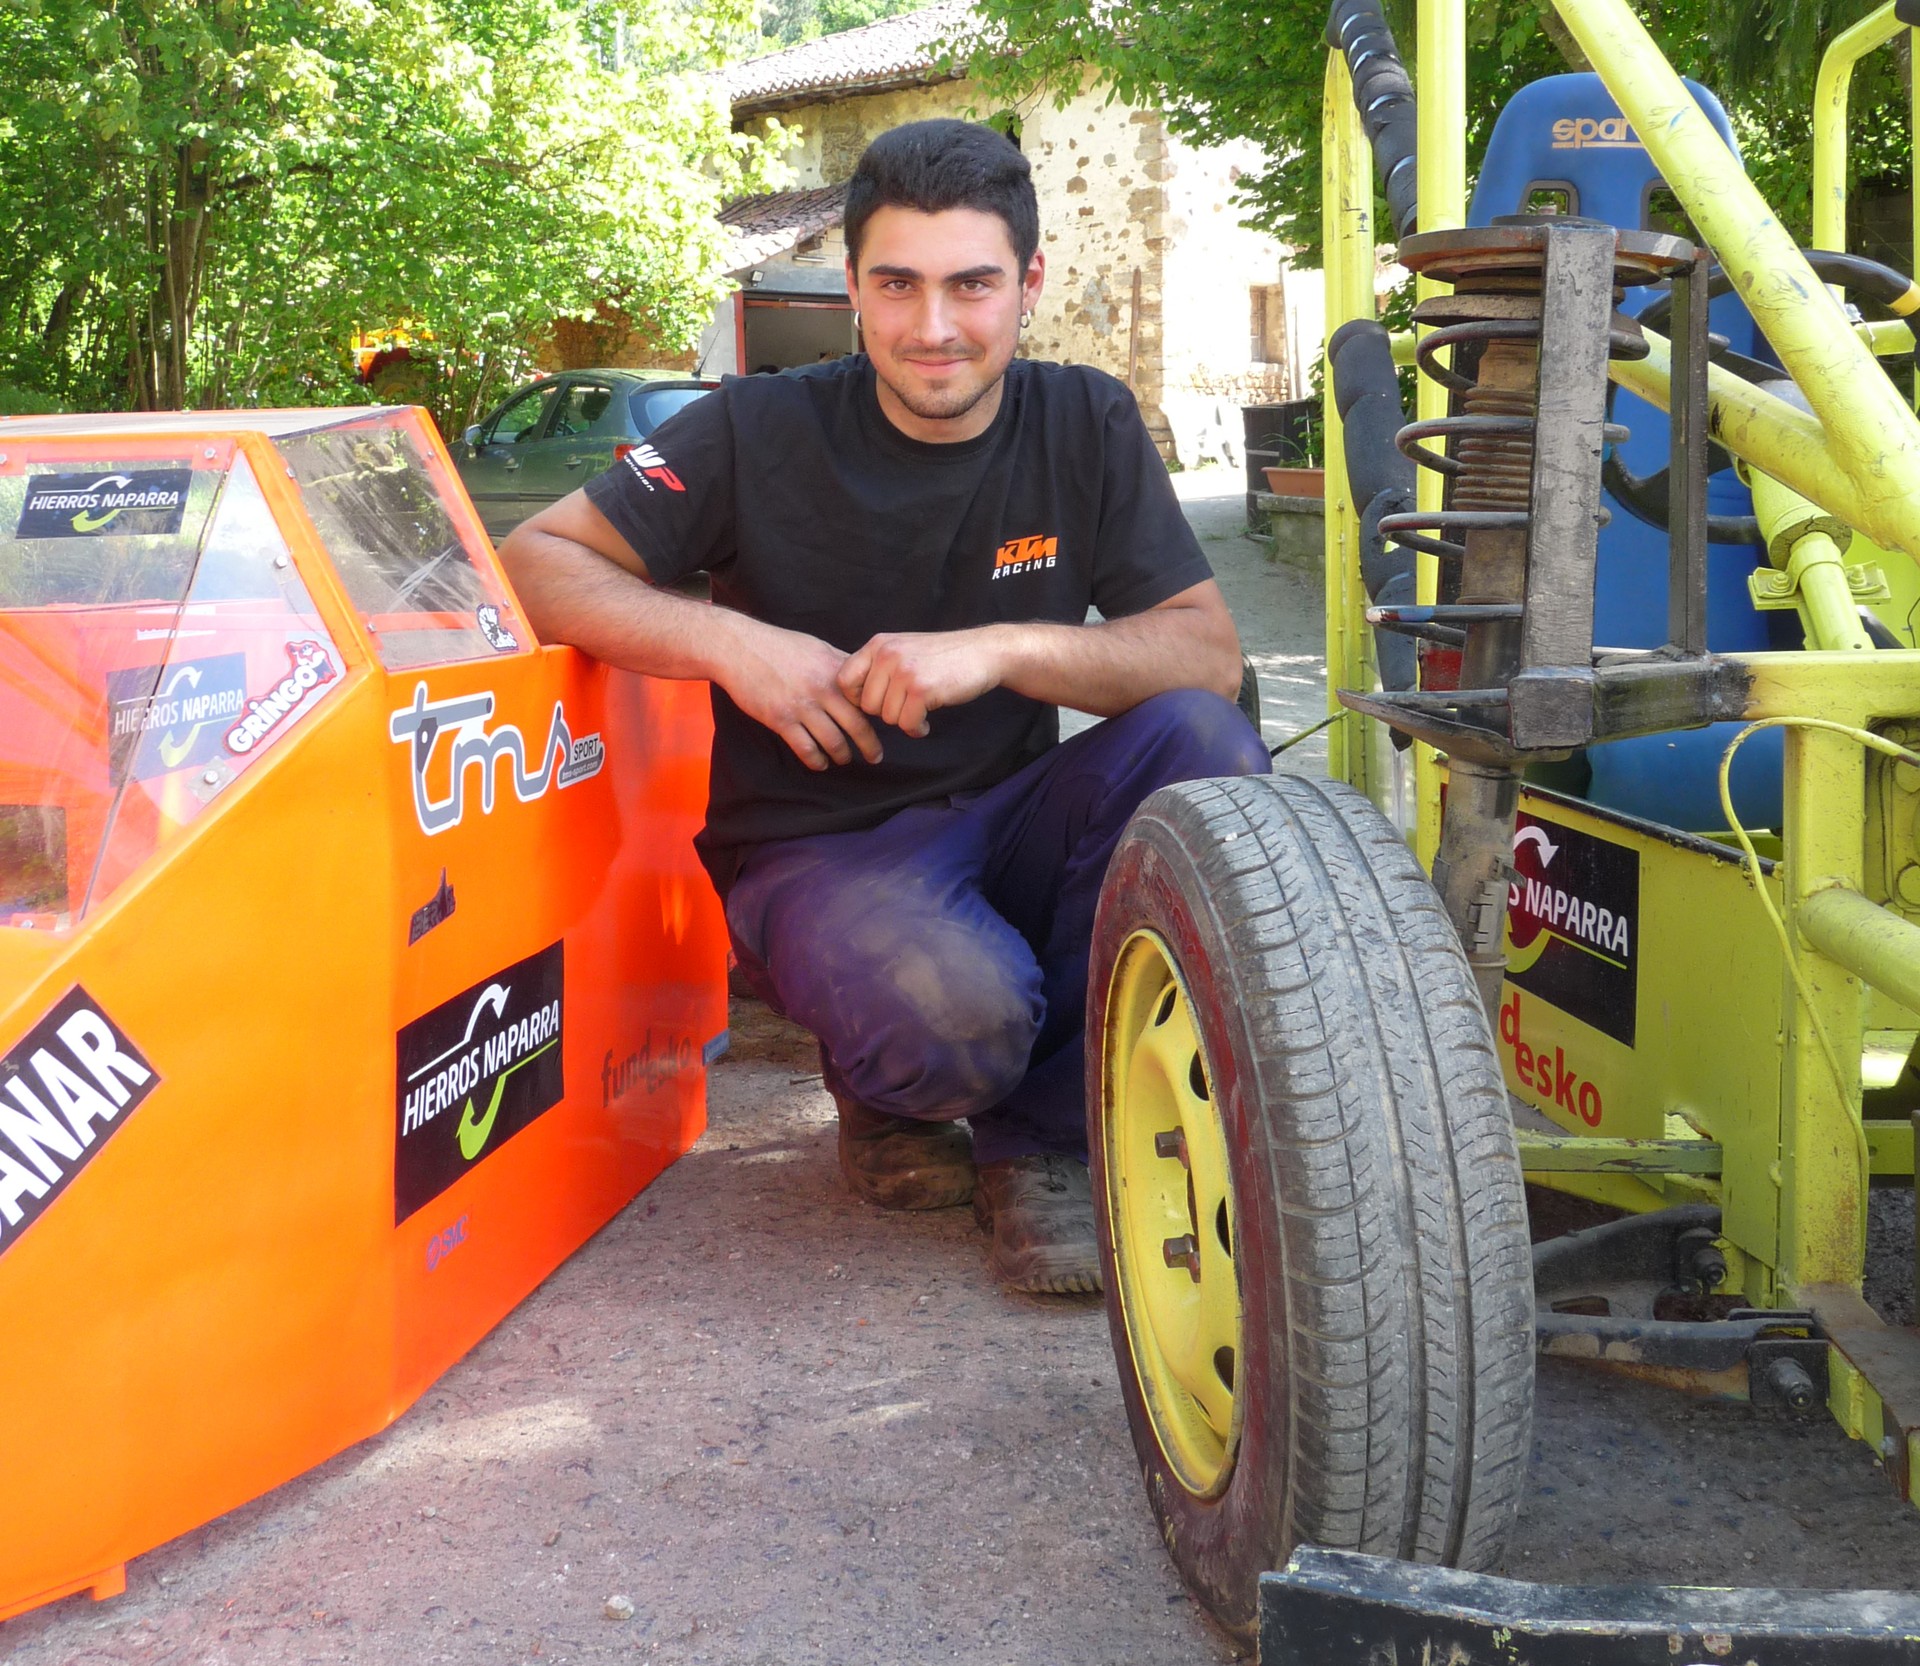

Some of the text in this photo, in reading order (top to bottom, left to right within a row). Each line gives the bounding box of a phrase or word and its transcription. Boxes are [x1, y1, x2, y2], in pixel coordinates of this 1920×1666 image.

[1552, 117, 1631, 149] spar
[628, 444, 686, 492] WP
[29, 491, 179, 510] HIERROS NAPARRA
[996, 534, 1058, 568] KTM
[114, 689, 244, 736] HIERROS NAPARRA
[573, 737, 599, 761] SPORT
[1525, 877, 1629, 958] NAPARRA
[402, 999, 560, 1137] HIERROS NAPARRA
[1500, 991, 1603, 1128] desko
[0, 1008, 152, 1238] ANAR
